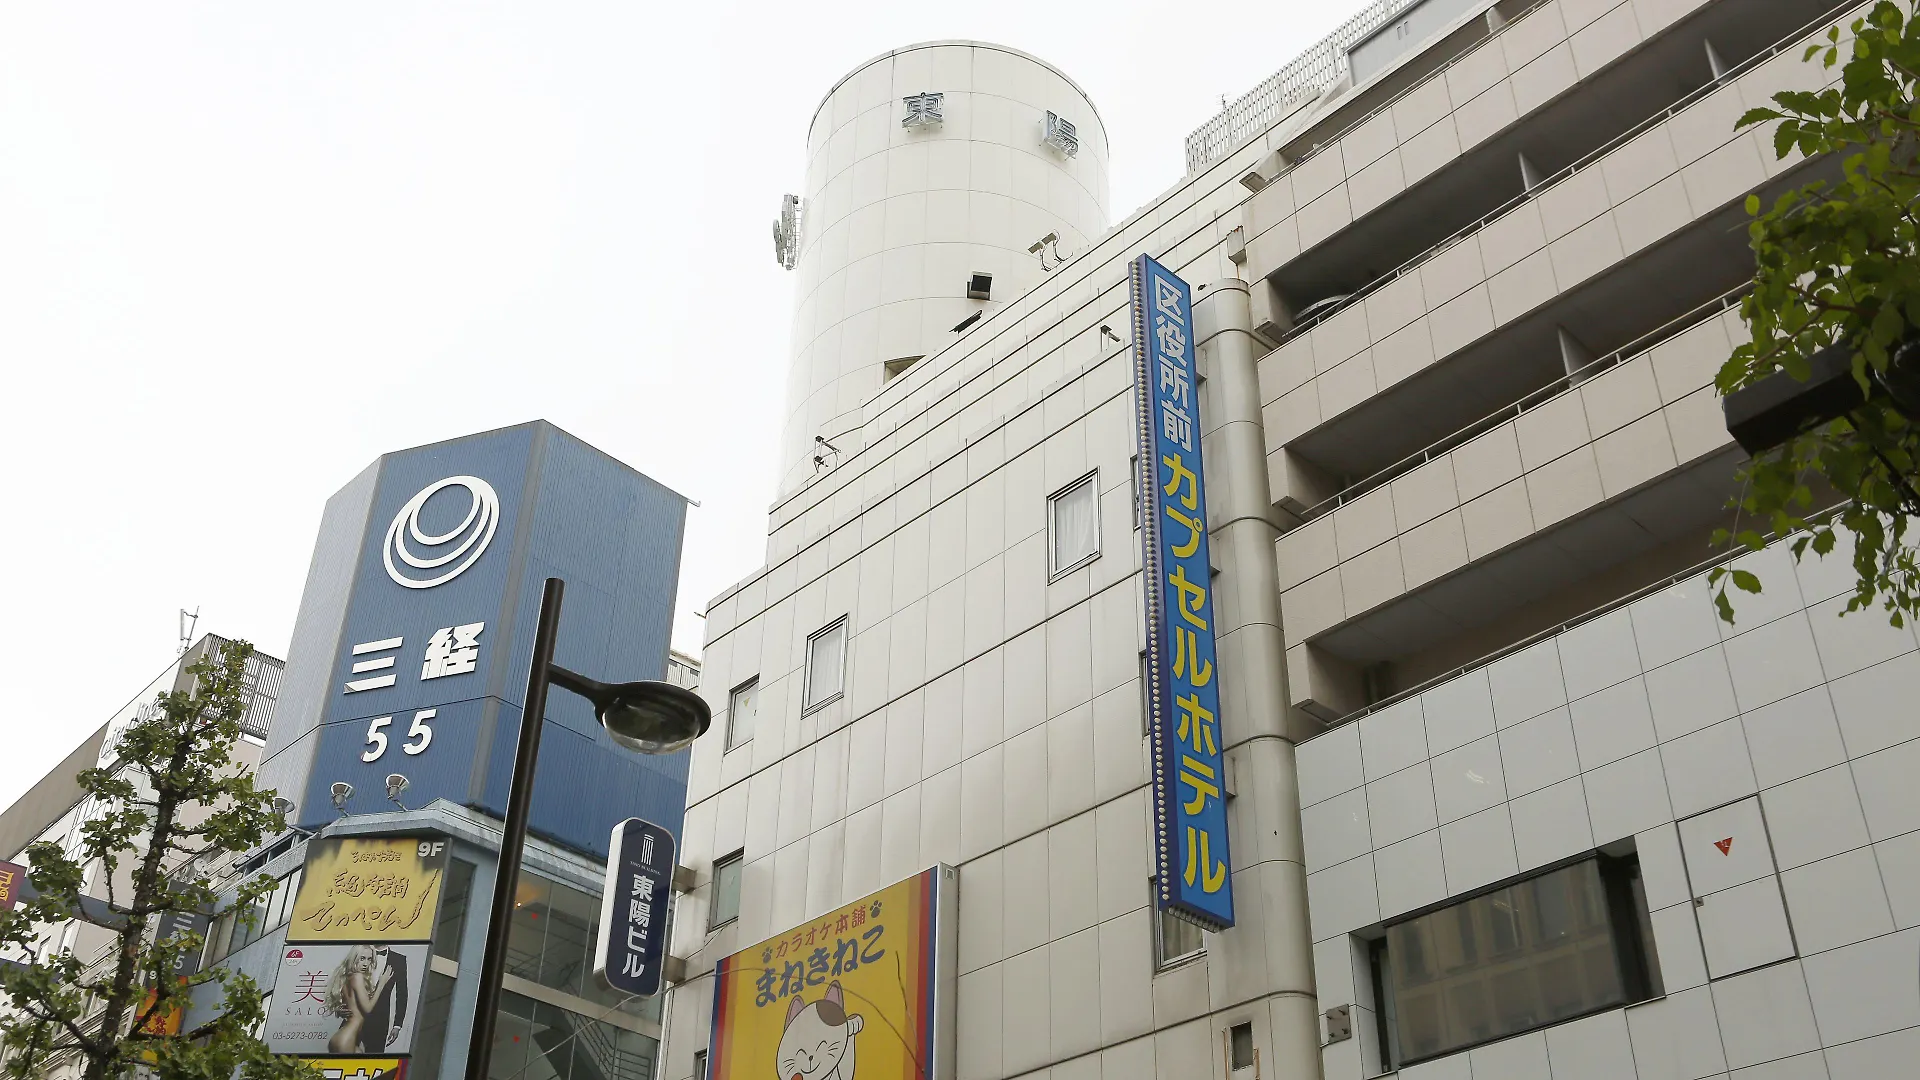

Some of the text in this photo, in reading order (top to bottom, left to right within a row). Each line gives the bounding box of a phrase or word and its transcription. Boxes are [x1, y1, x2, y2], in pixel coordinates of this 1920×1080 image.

[902, 92, 1079, 156] 東陽
[1154, 273, 1226, 894] 区役所前カプセルホテル
[343, 621, 485, 694] 三経
[360, 709, 437, 763] 55
[417, 842, 445, 858] 9F
[621, 873, 655, 979] 東陽ビル
[775, 904, 867, 959] カラオケ本舗
[291, 970, 328, 1004] 美
[755, 924, 886, 1008] まねきねこ
[272, 1031, 329, 1041] 03-5273-0782
